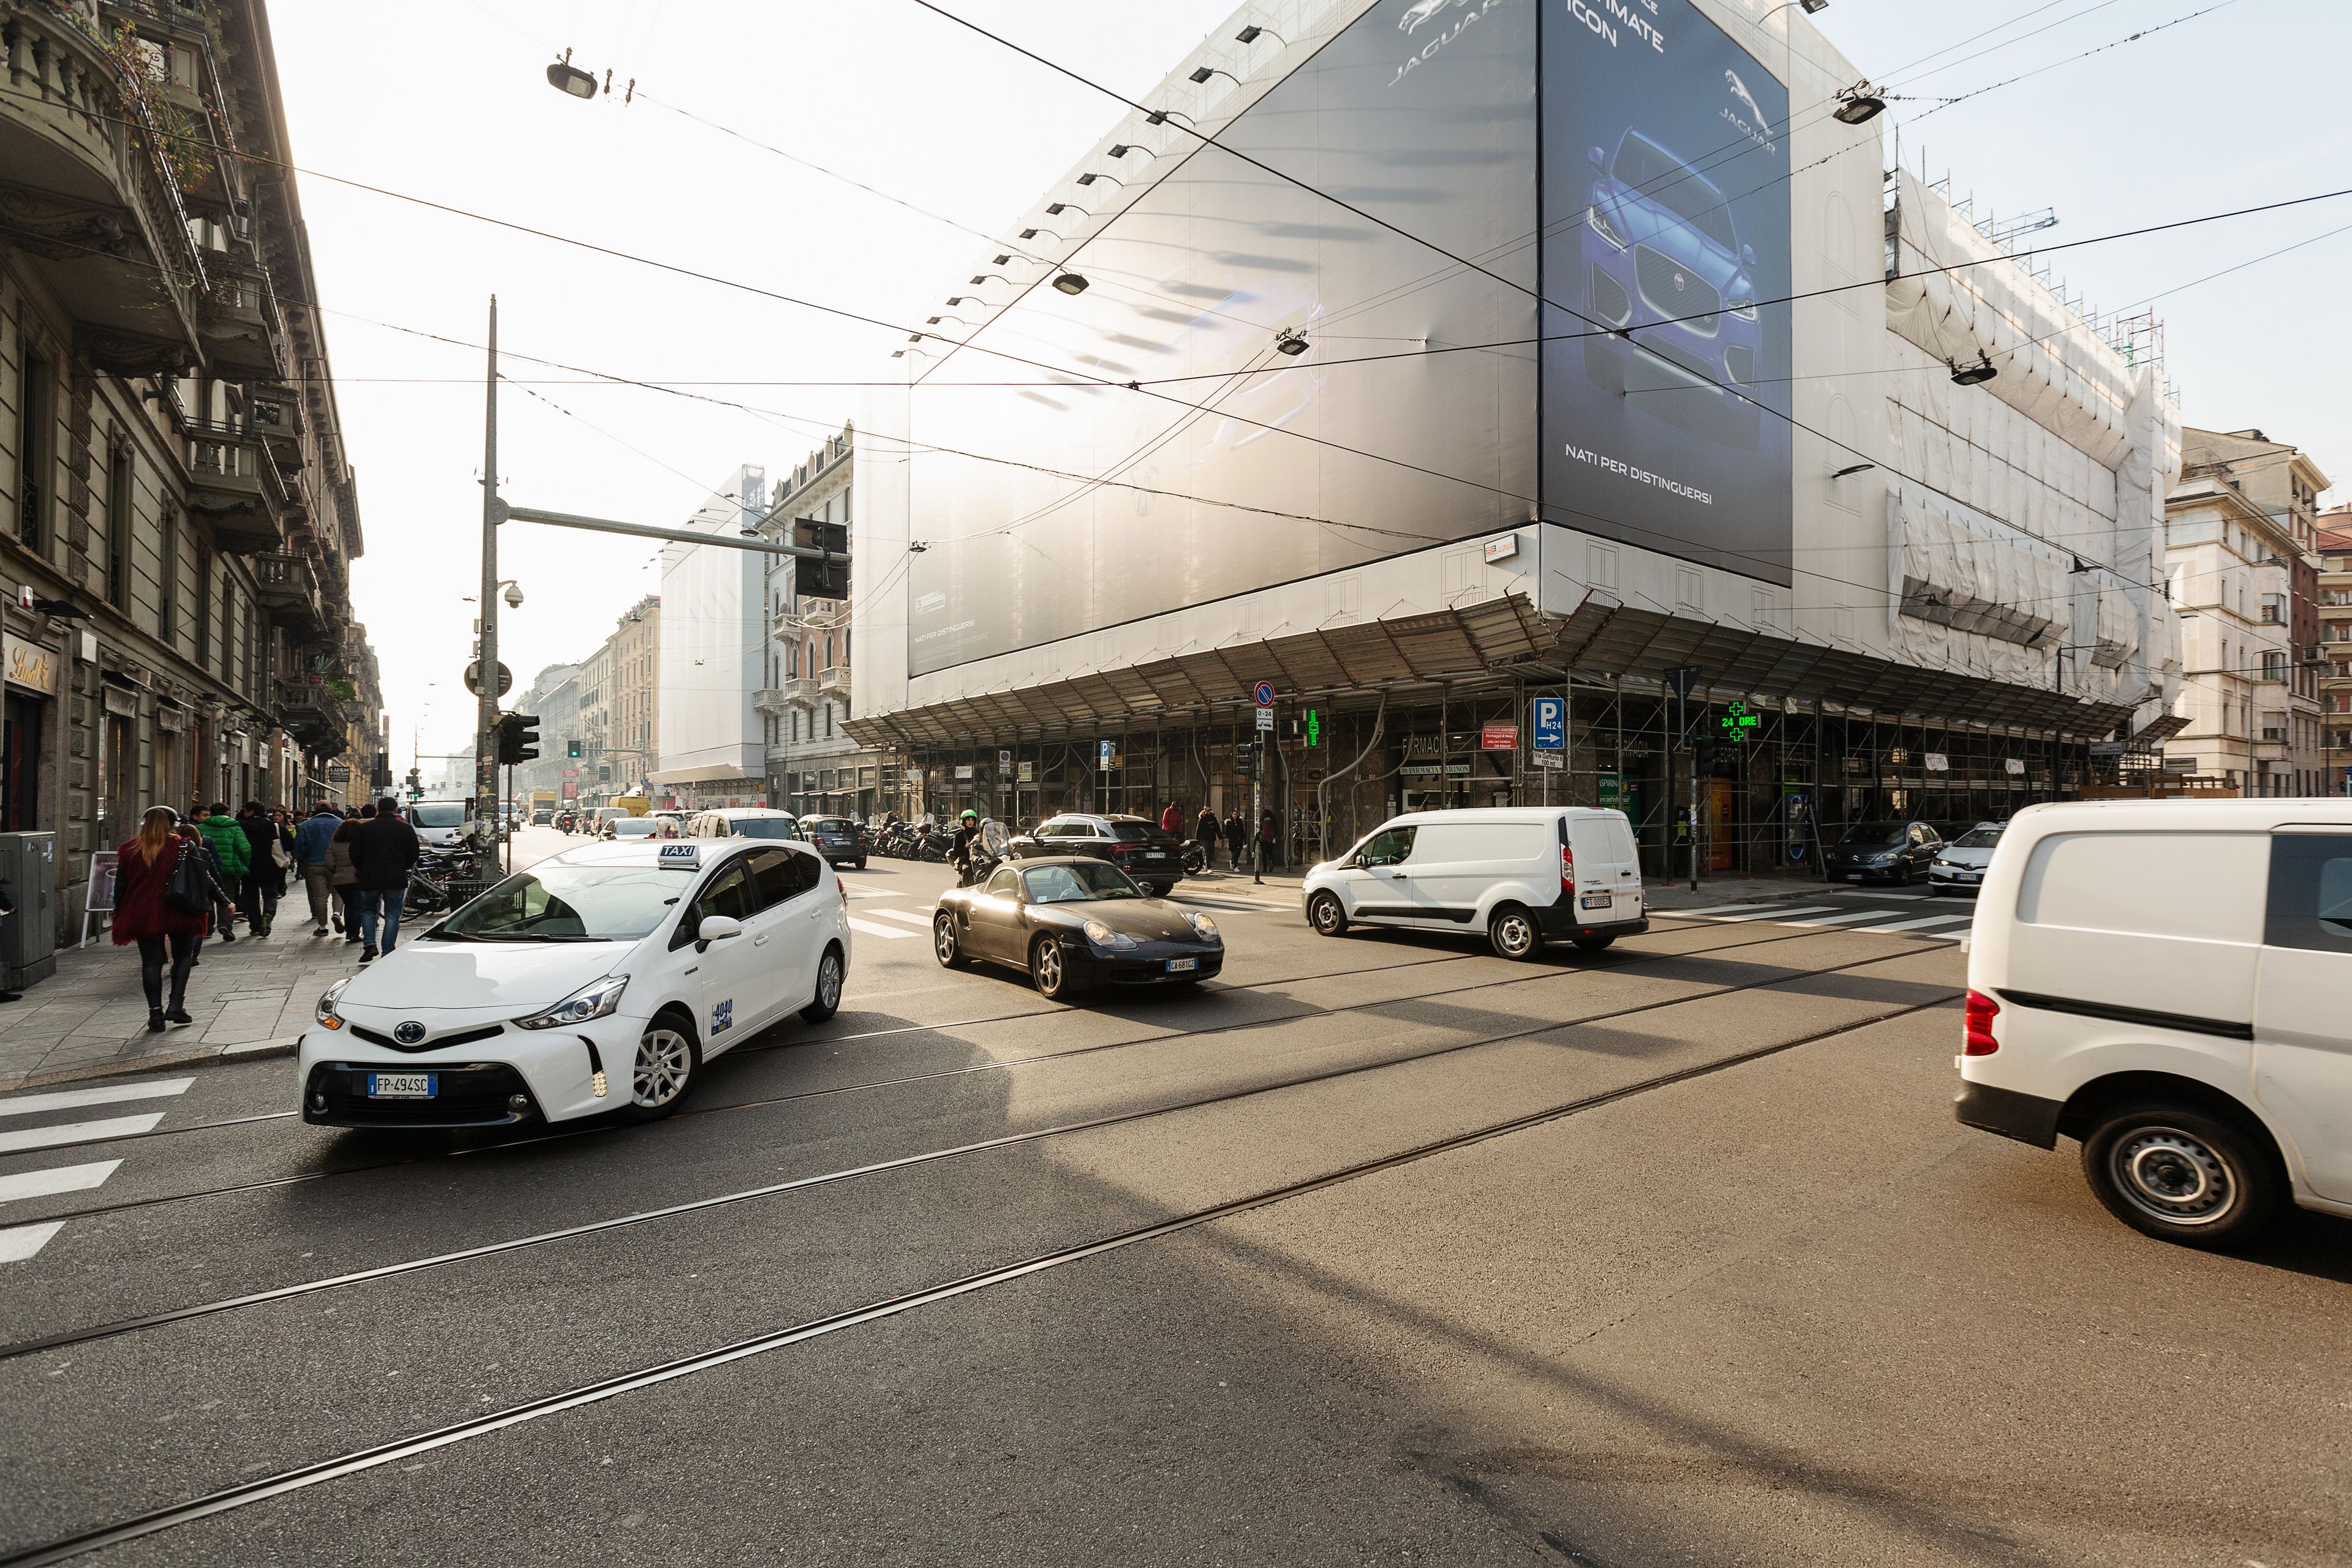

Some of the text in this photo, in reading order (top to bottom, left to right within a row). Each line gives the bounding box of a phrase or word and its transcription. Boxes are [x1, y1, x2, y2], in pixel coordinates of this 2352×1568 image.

[1567, 0, 1617, 48] ICON
[1719, 107, 1776, 156] JAGUAR
[1566, 443, 1712, 505] NATI PER DISTINGUERSI
[914, 619, 975, 644] NATI PER DISTINGUERSI
[10, 647, 43, 686] Lindt
[1540, 703, 1557, 728] P
[1722, 716, 1757, 727] 24 ORE
[1615, 739, 1649, 758] FRMACIA
[1439, 764, 1469, 774] ARINON
[664, 846, 694, 856] TAXI
[715, 998, 733, 1022] 4040
